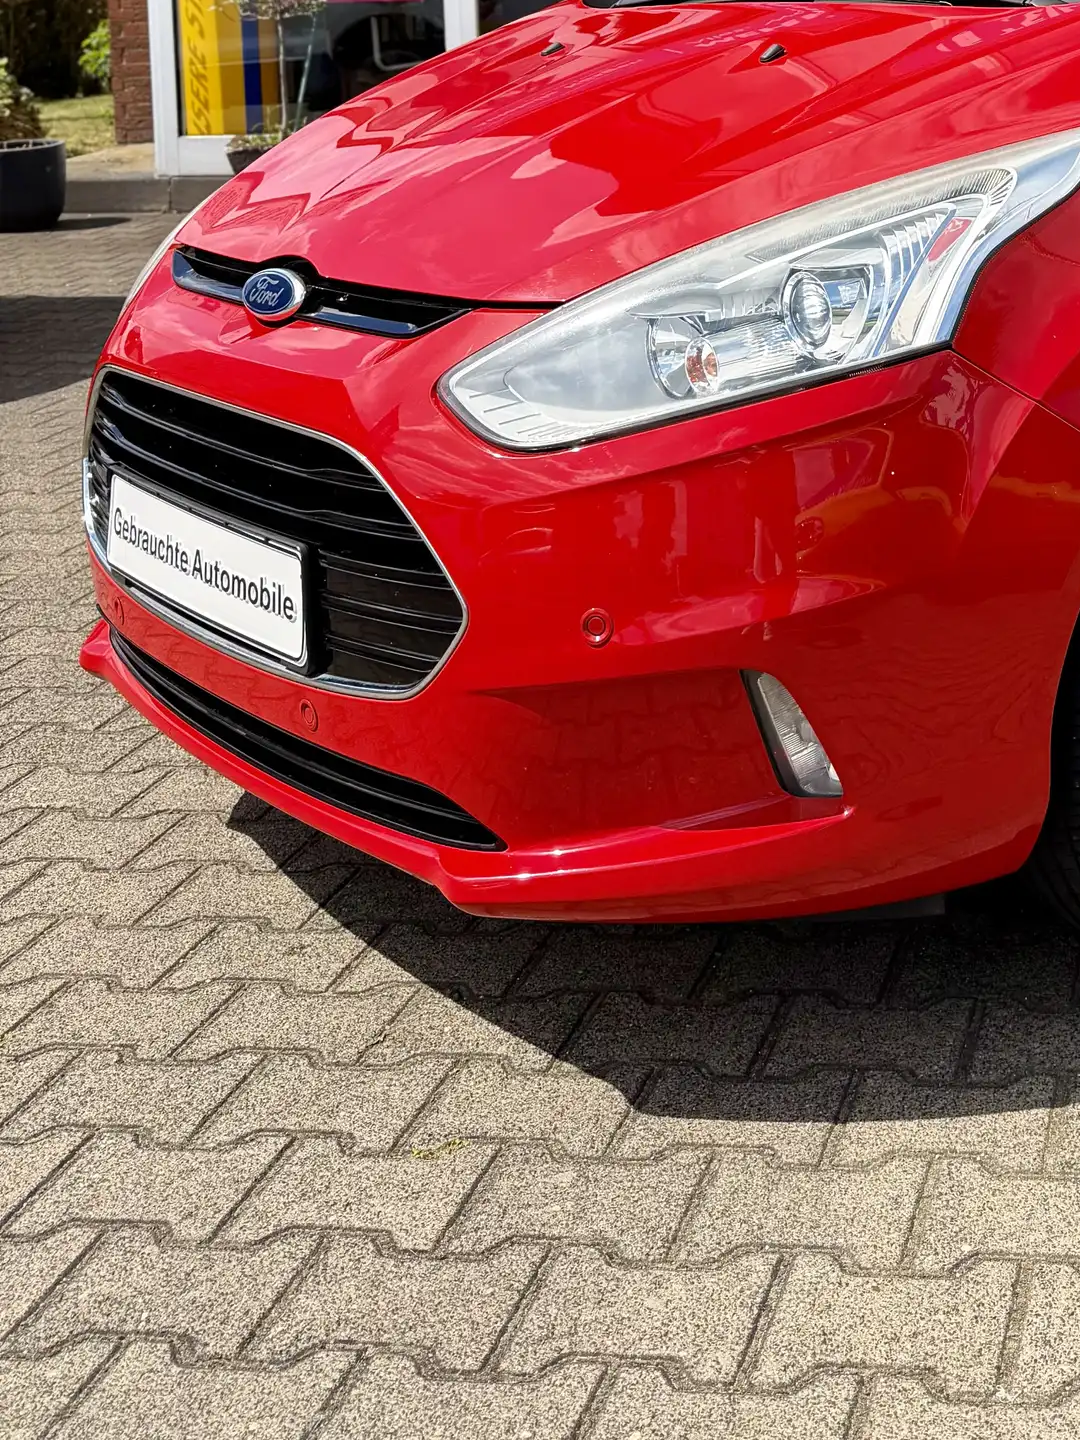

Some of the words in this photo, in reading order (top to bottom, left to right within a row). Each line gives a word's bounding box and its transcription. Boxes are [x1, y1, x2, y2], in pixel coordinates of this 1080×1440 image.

[248, 275, 283, 308] Ford
[113, 507, 189, 576] Gebrauchte
[192, 548, 297, 622] Automobile
